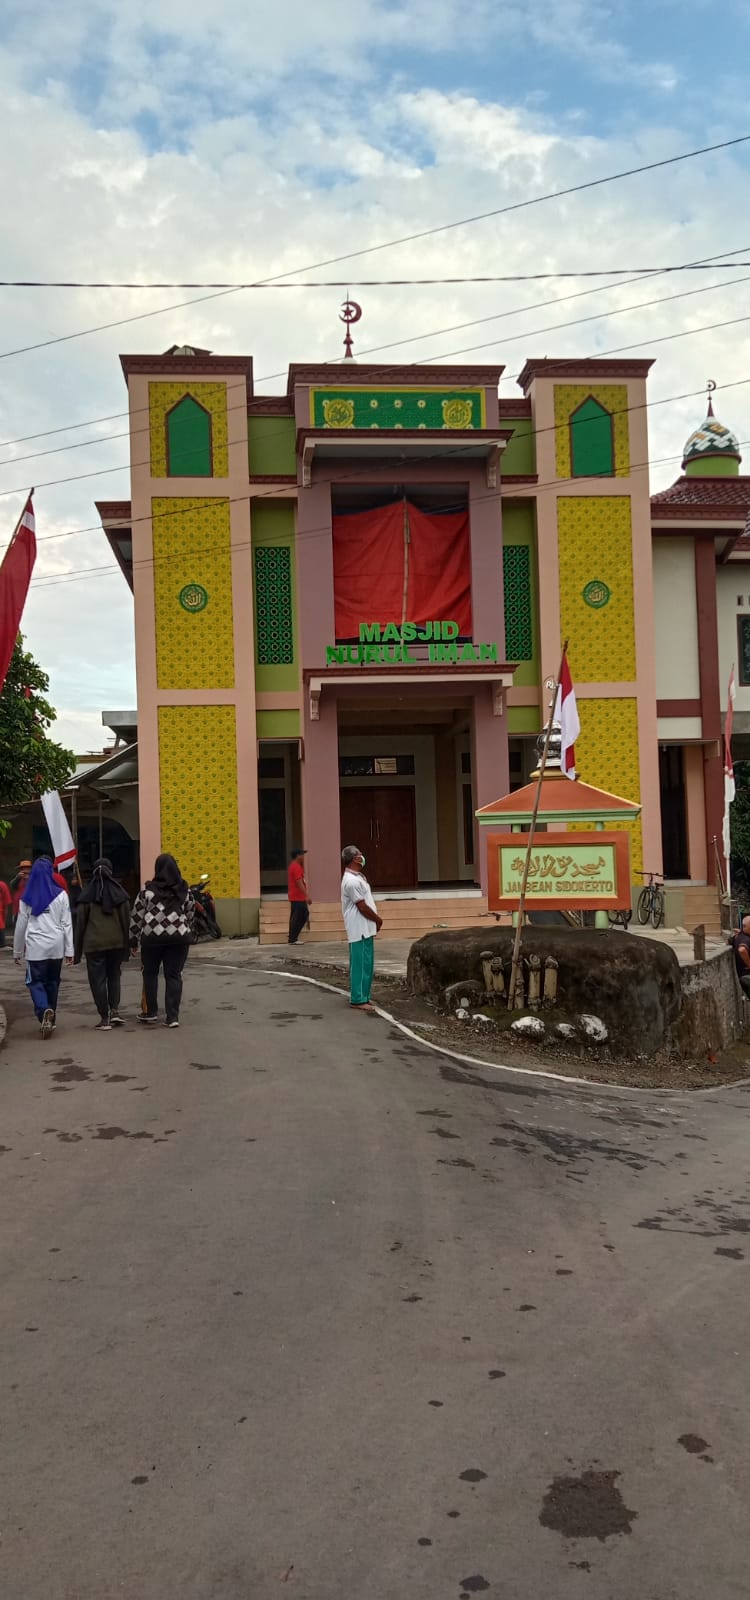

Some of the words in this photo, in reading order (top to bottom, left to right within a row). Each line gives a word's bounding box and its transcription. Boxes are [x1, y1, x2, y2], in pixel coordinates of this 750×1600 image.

[359, 621, 459, 642] MASJID
[326, 645, 416, 664] NURUL
[428, 643, 498, 663] IMAN
[556, 880, 613, 892] SIDOKERTO
